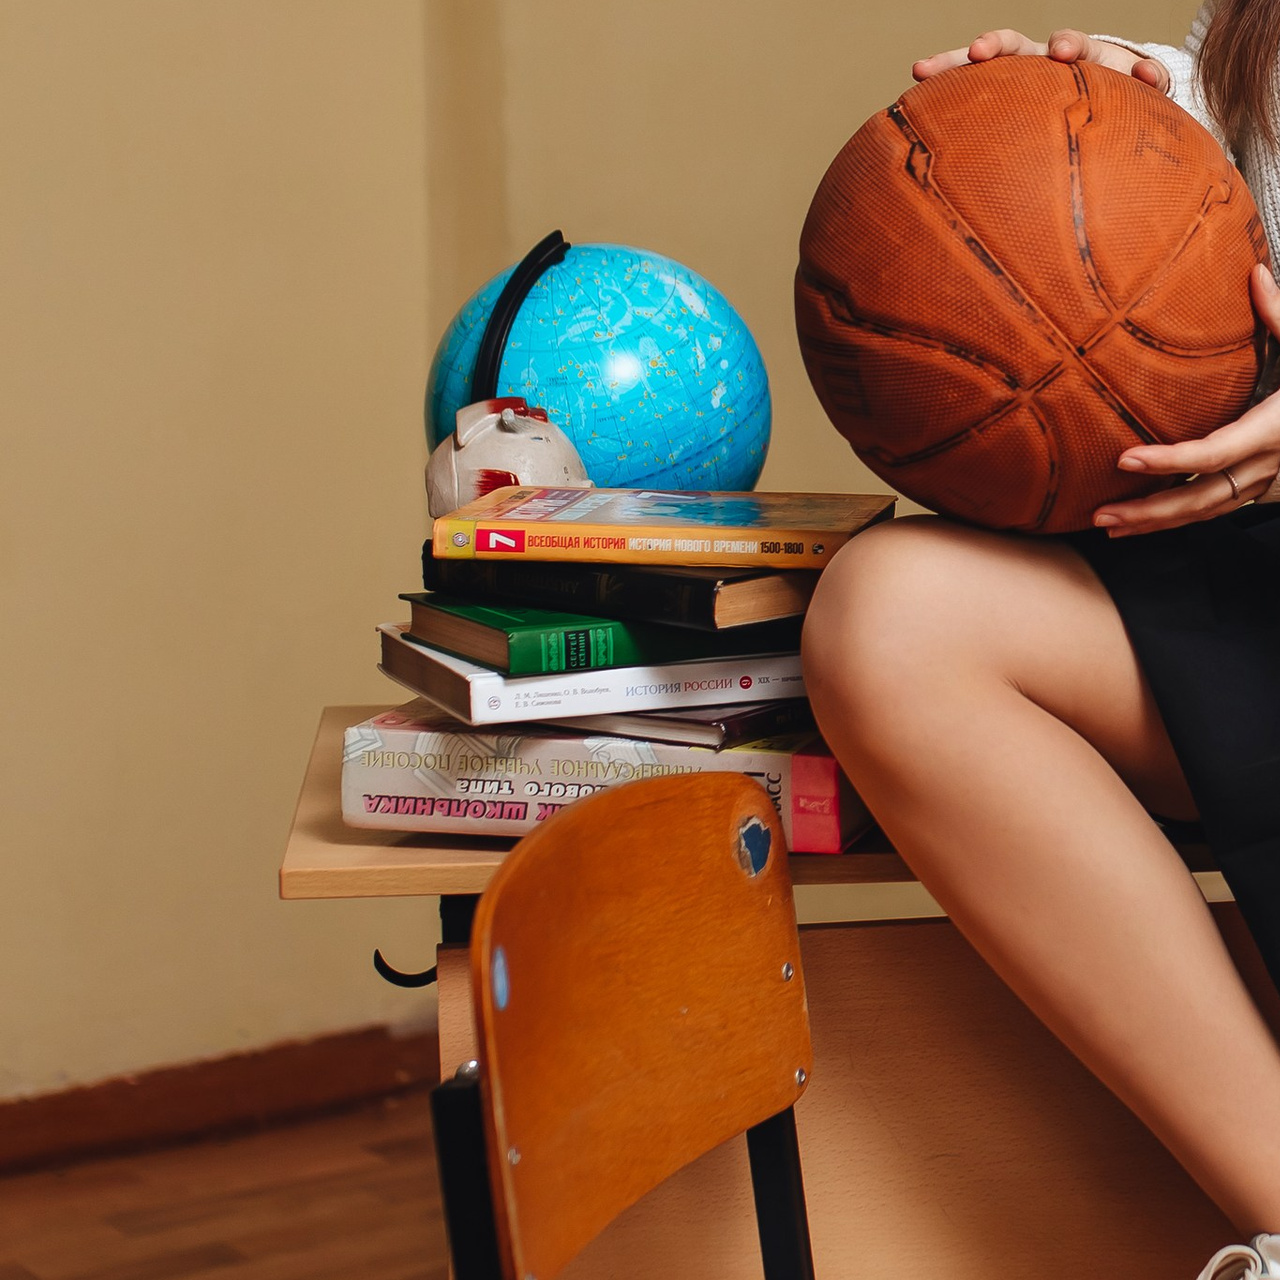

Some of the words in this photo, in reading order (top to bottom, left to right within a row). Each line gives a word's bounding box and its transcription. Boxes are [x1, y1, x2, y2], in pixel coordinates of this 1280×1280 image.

[489, 532, 516, 549] 7
[527, 535, 580, 551] ВСЕОБЩАЯ
[583, 537, 626, 550] ИСТОРИЯ
[628, 538, 672, 550] ИСТОРИЯ
[674, 539, 711, 552] НОВОГО
[713, 540, 758, 554] ВРЕМЕНИ
[760, 541, 804, 554] 1500-1800
[568, 633, 578, 667] СЕРГЕЙ
[625, 682, 681, 697] ИСТОРИЯ
[684, 678, 733, 692] РОССИИ
[757, 676, 771, 684] XIX
[360, 750, 450, 770] ПОСОБИЕ
[459, 754, 543, 776] УЧЕБНОЕ
[550, 759, 702, 780] ИВЕРСАЛЬНОЕ
[455, 778, 515, 796] типа
[362, 793, 531, 821] ШКОЛЬНИКА
